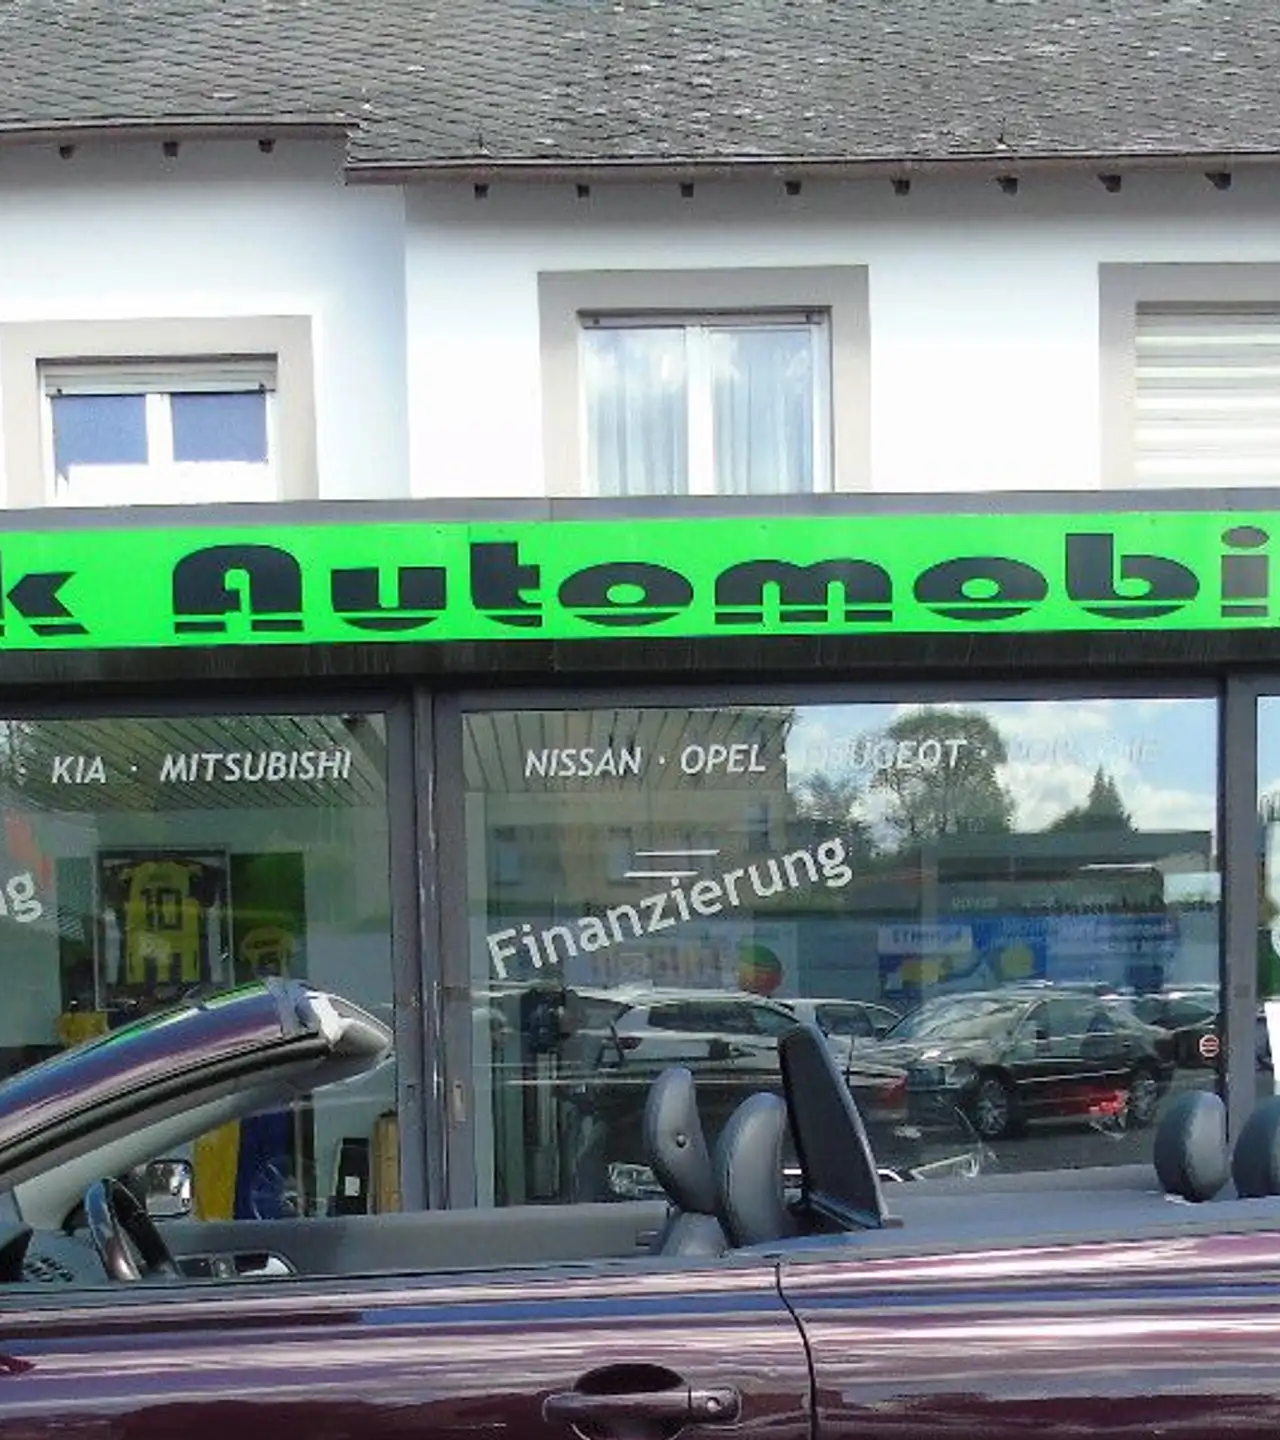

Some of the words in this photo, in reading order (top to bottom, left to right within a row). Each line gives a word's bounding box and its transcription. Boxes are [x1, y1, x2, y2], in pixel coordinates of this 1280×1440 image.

[51, 755, 108, 784] KIA
[160, 749, 352, 783] MITSUBISHI
[524, 745, 641, 778] NISSAN
[680, 742, 768, 774] OPEL
[486, 838, 854, 981] Finanzierung
